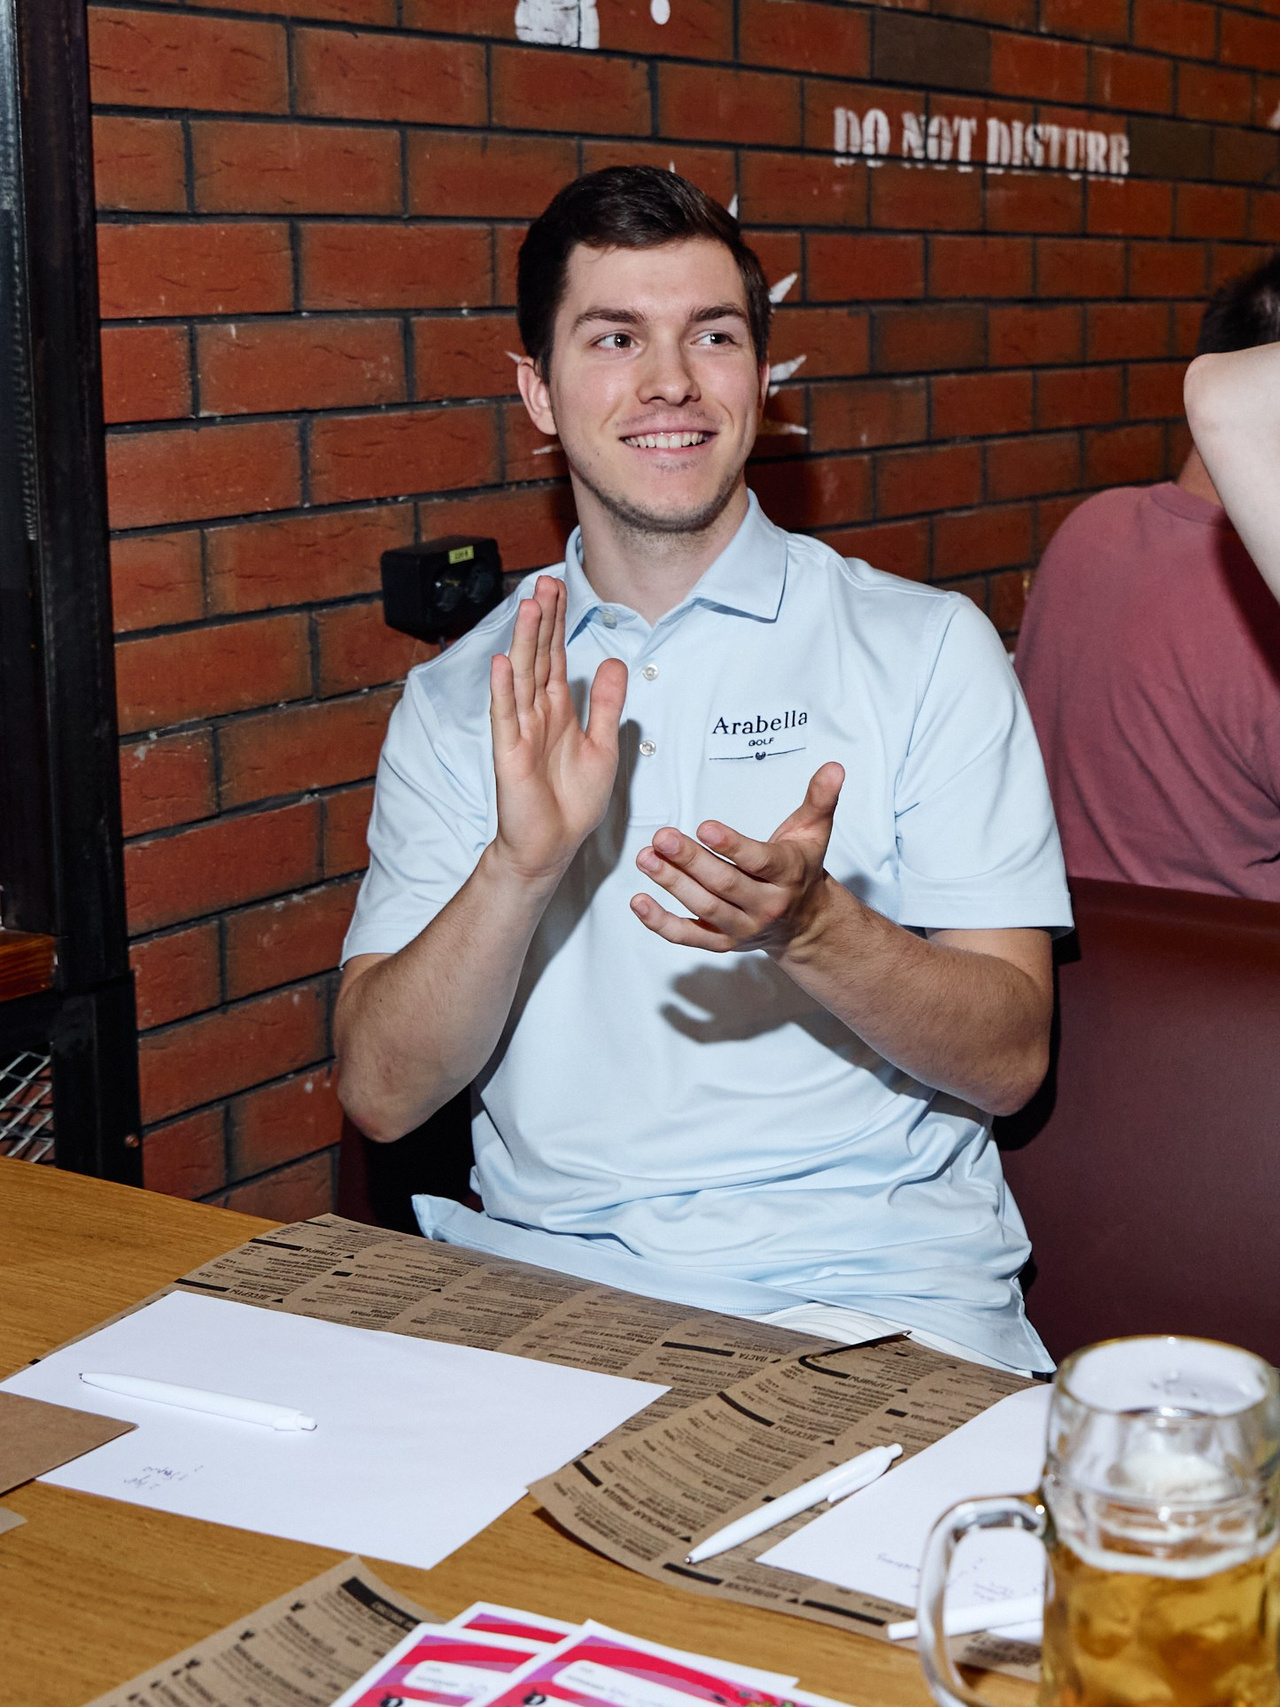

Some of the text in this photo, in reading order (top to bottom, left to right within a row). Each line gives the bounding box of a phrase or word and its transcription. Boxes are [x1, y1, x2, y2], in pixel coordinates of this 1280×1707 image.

[834, 106, 1130, 185] DO NOT DISTURB
[712, 709, 808, 735] Arabella
[748, 736, 775, 747] GOLF
[737, 1352, 769, 1363] ПАСТА
[775, 1424, 820, 1442] ДЕСЕРТЫ
